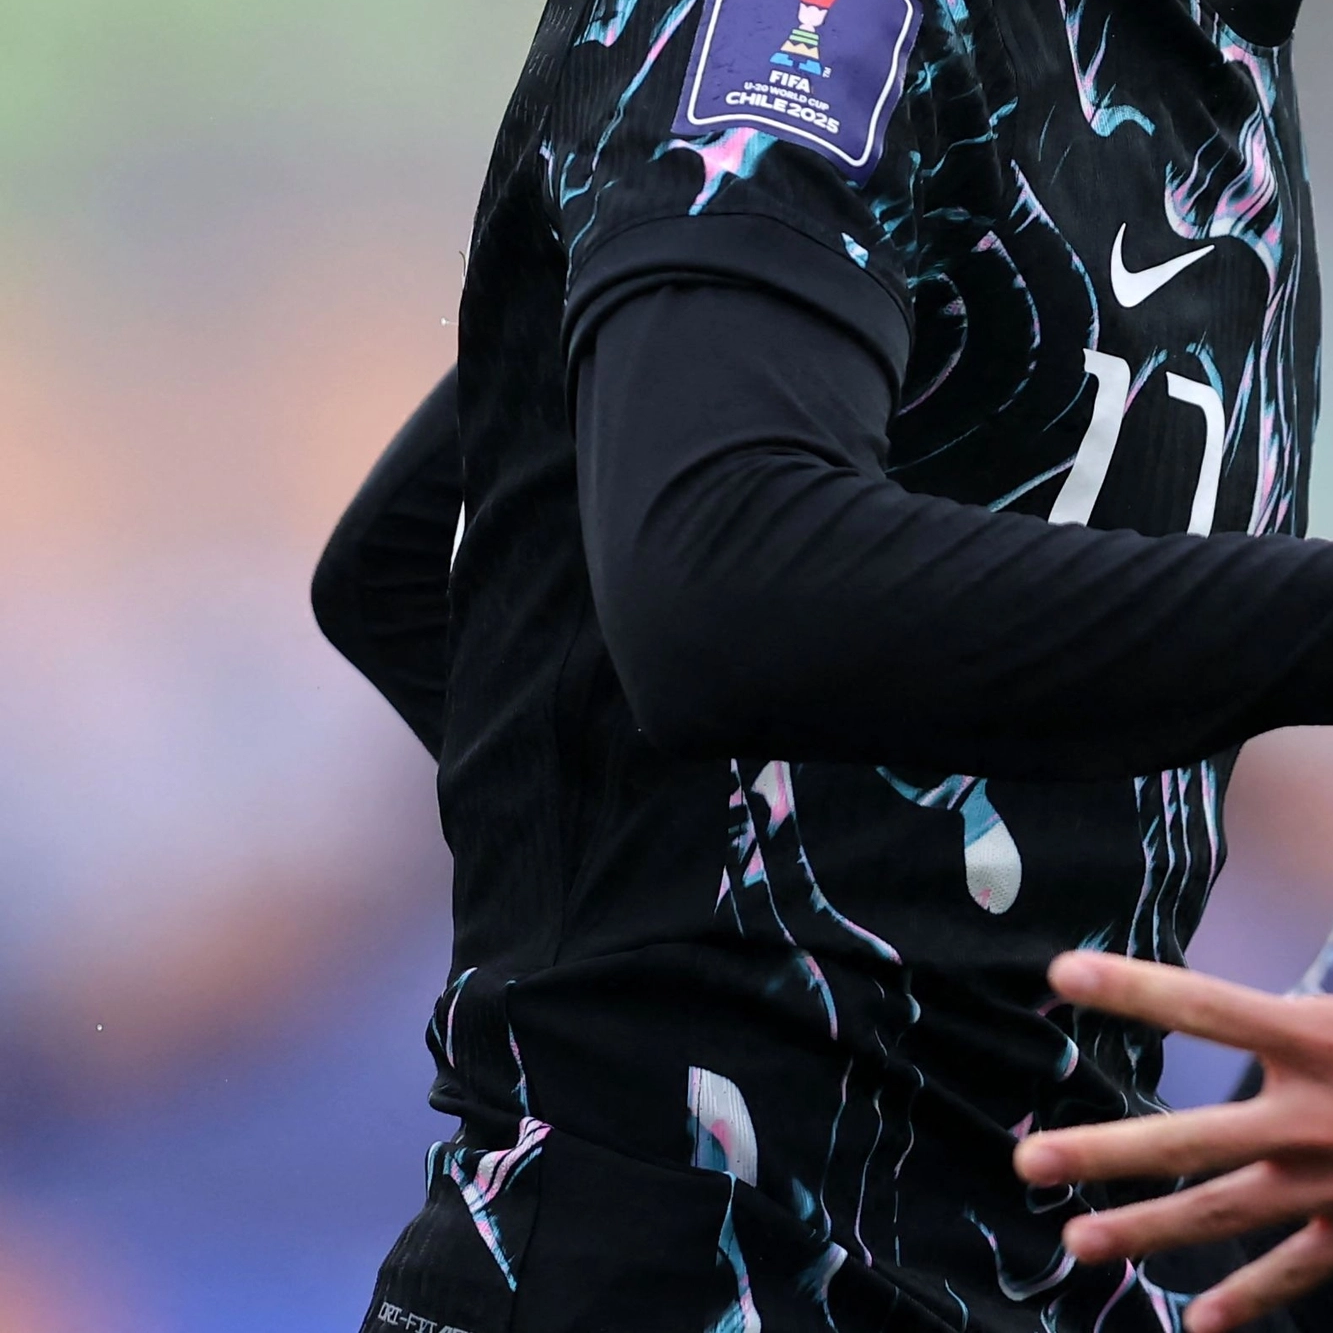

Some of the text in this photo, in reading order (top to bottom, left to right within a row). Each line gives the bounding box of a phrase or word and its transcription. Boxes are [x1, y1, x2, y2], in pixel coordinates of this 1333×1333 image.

[769, 70, 811, 94] FIFA
[744, 82, 830, 111] U-20 WORLD CUP
